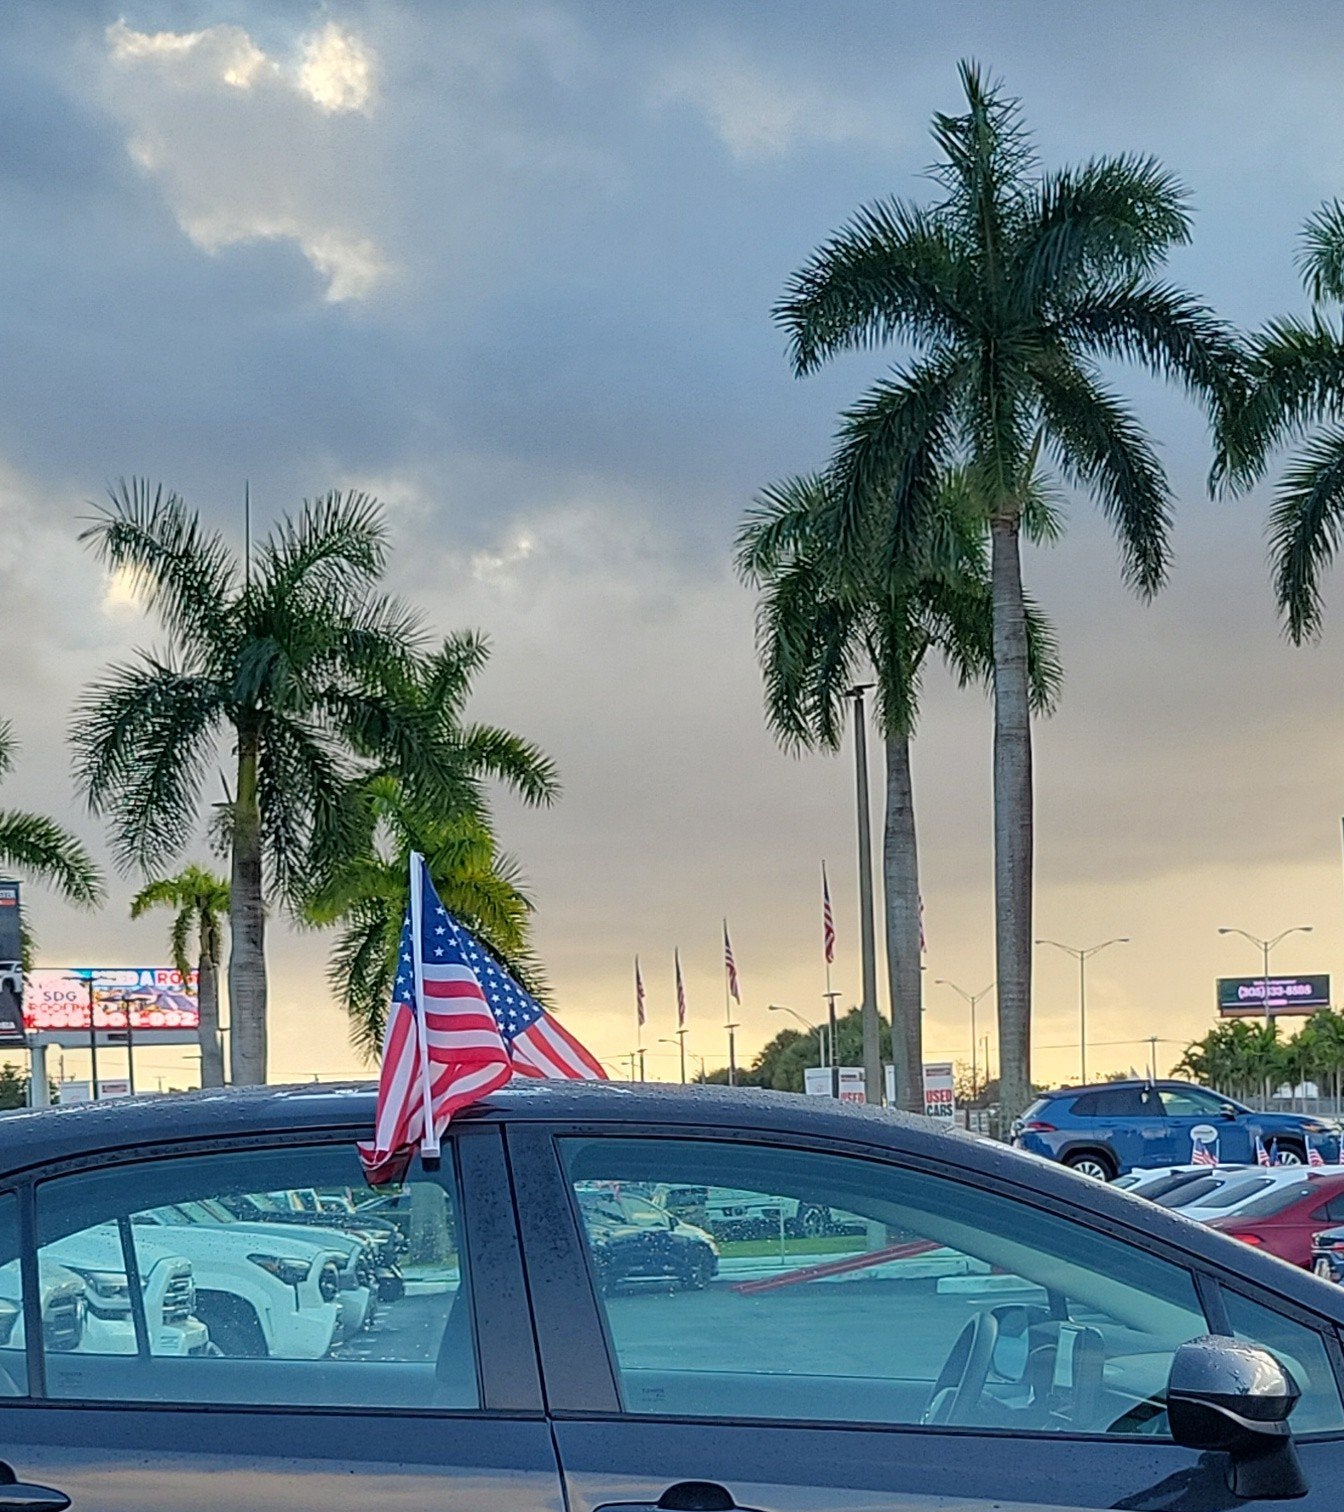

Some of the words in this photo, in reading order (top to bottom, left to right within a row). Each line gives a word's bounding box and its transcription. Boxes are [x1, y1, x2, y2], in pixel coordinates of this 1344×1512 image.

[43, 991, 77, 1002] SDG
[926, 1089, 952, 1103] USED
[927, 1104, 953, 1117] CARS
